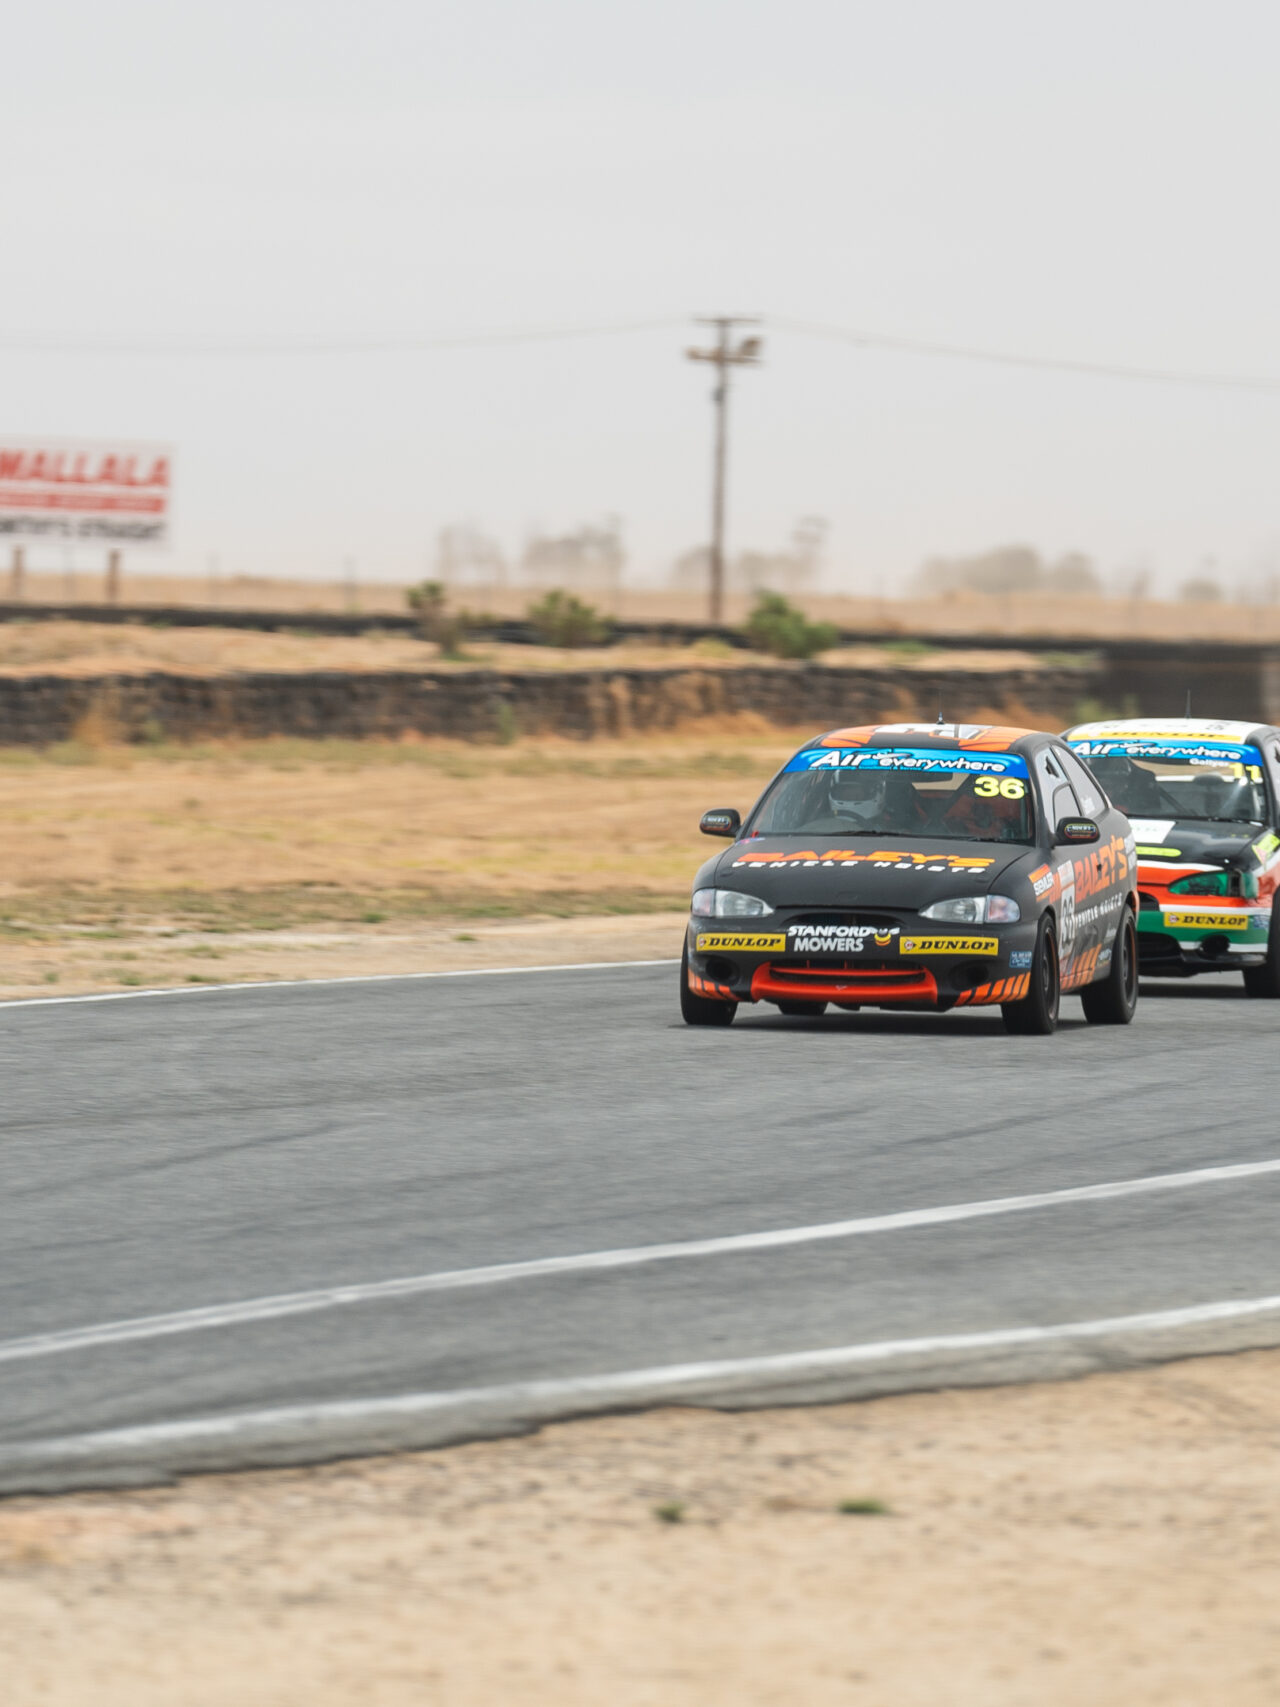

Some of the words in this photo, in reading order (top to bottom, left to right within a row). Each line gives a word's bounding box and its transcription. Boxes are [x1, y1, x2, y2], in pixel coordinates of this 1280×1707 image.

[1071, 742, 1124, 756] Air
[1126, 744, 1243, 761] everywhere
[810, 750, 873, 768] Air
[879, 753, 1006, 773] everywhere
[973, 775, 1026, 800] 36
[739, 849, 996, 868] BAILEY'S
[731, 860, 859, 869] VEHICLE
[873, 860, 987, 874] HOISTS
[1074, 835, 1127, 903] BAILEY'S
[1183, 915, 1246, 926] DUNLOP
[787, 925, 871, 938] STANFORD
[709, 938, 781, 948] DUNLOP
[793, 937, 865, 952] MOWERS
[919, 940, 995, 951] DUNLOP
